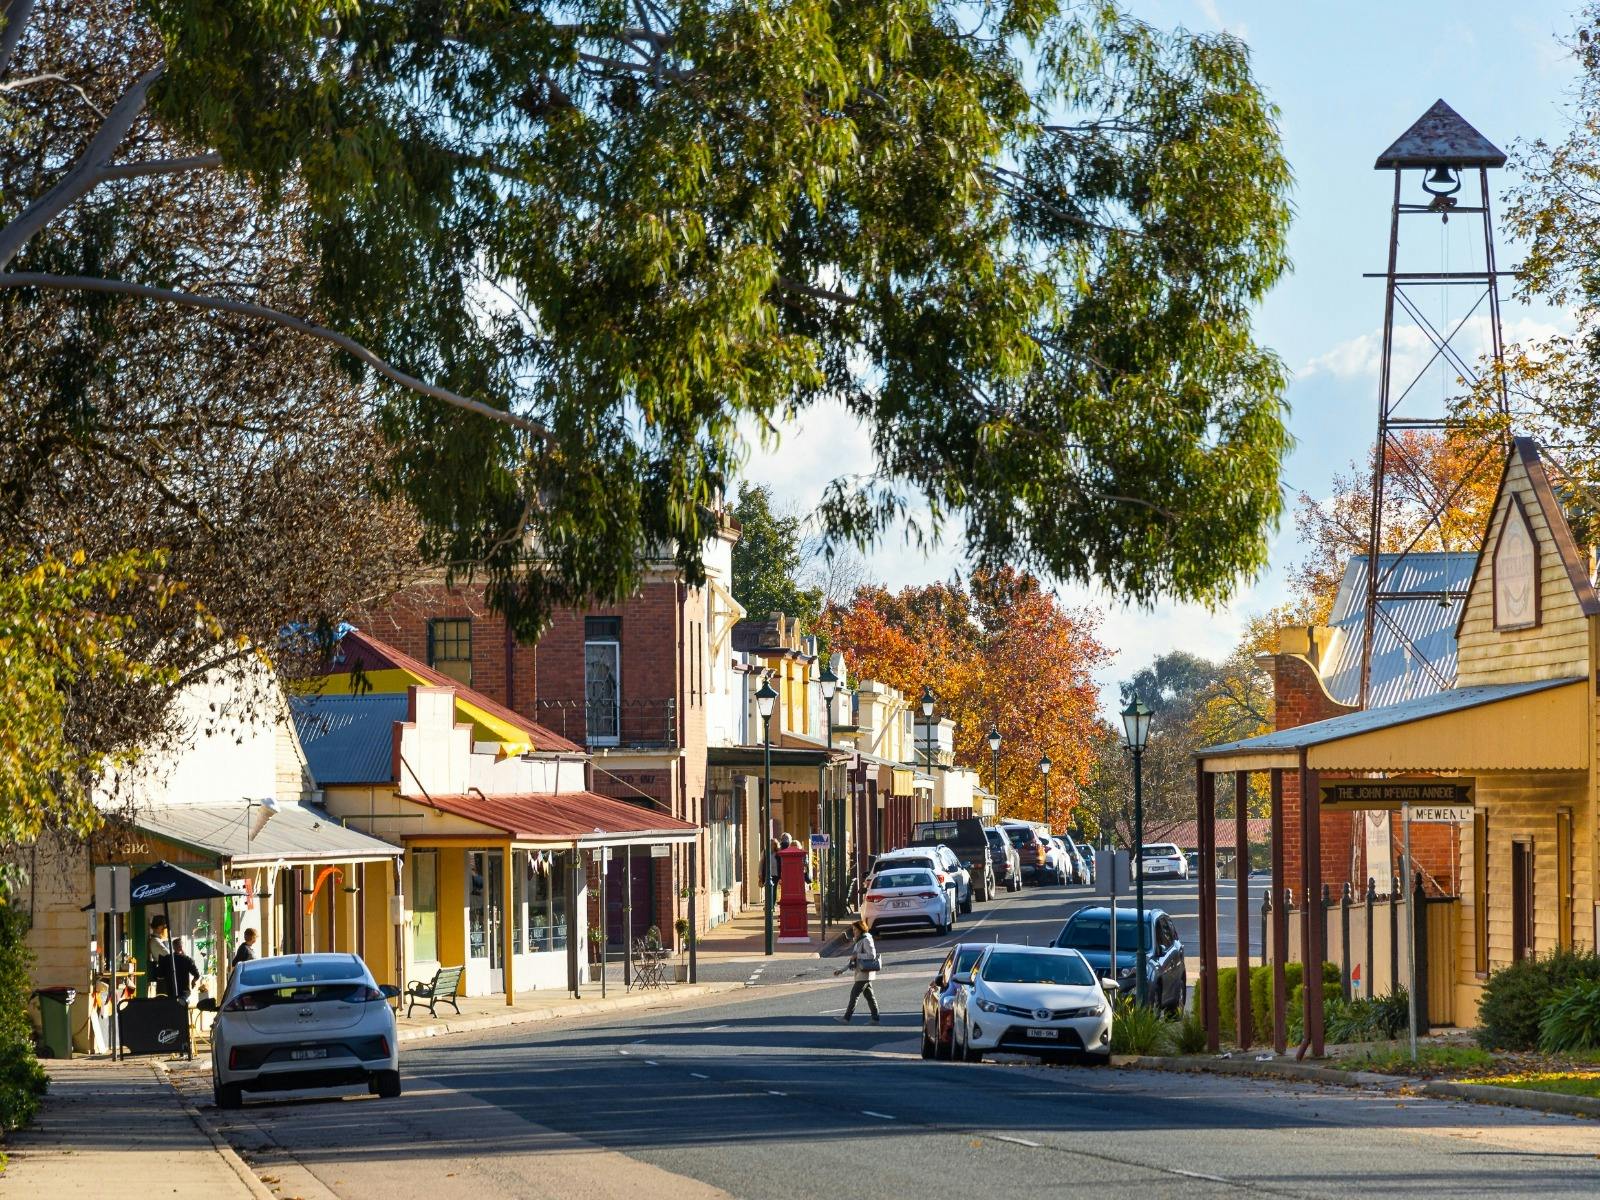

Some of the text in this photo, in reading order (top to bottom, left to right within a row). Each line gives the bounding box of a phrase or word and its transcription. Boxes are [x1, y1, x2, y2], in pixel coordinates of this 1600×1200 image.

[1338, 787, 1354, 799] THE
[1357, 787, 1381, 799] JOHN
[1422, 786, 1454, 798] ANNEXE
[132, 882, 177, 899] Genovese
